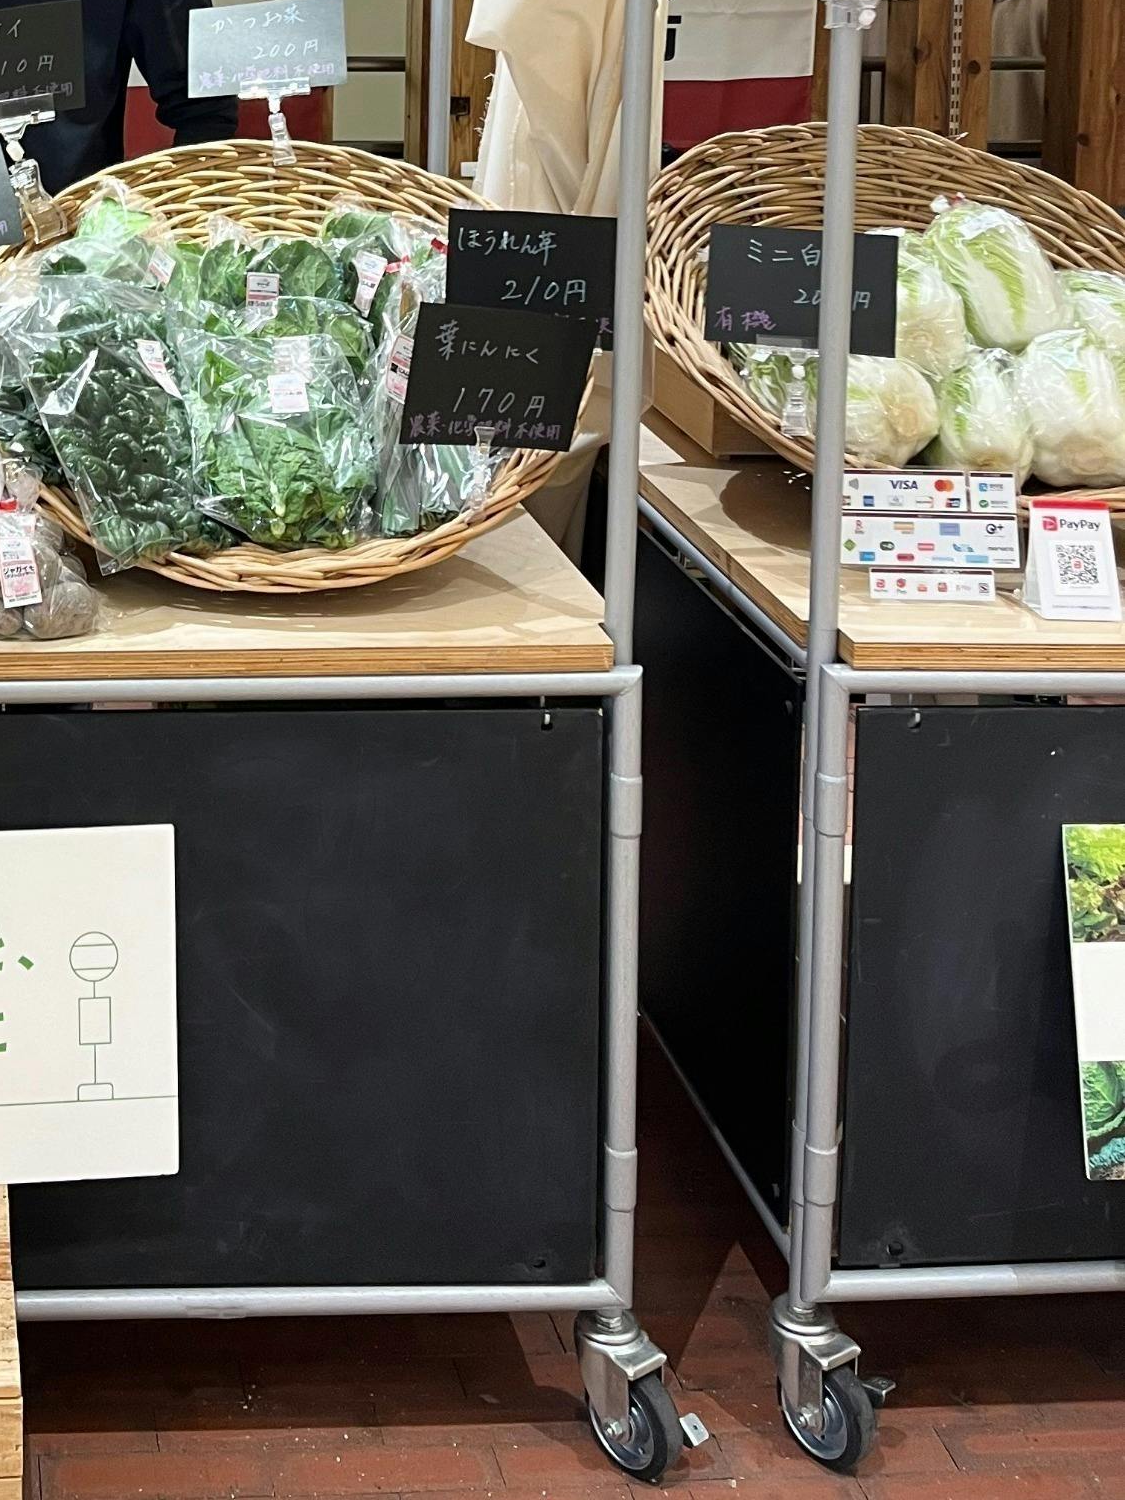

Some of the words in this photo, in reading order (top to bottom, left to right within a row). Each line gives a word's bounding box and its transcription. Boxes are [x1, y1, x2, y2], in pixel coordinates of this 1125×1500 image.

[252, 38, 319, 60] 200円
[457, 227, 558, 267] ほうれん草
[501, 275, 587, 306] 210円
[435, 319, 539, 365] 葉にんにく
[452, 387, 545, 419] 170円
[888, 480, 918, 490] VISA
[1059, 519, 1100, 531] PayPay
